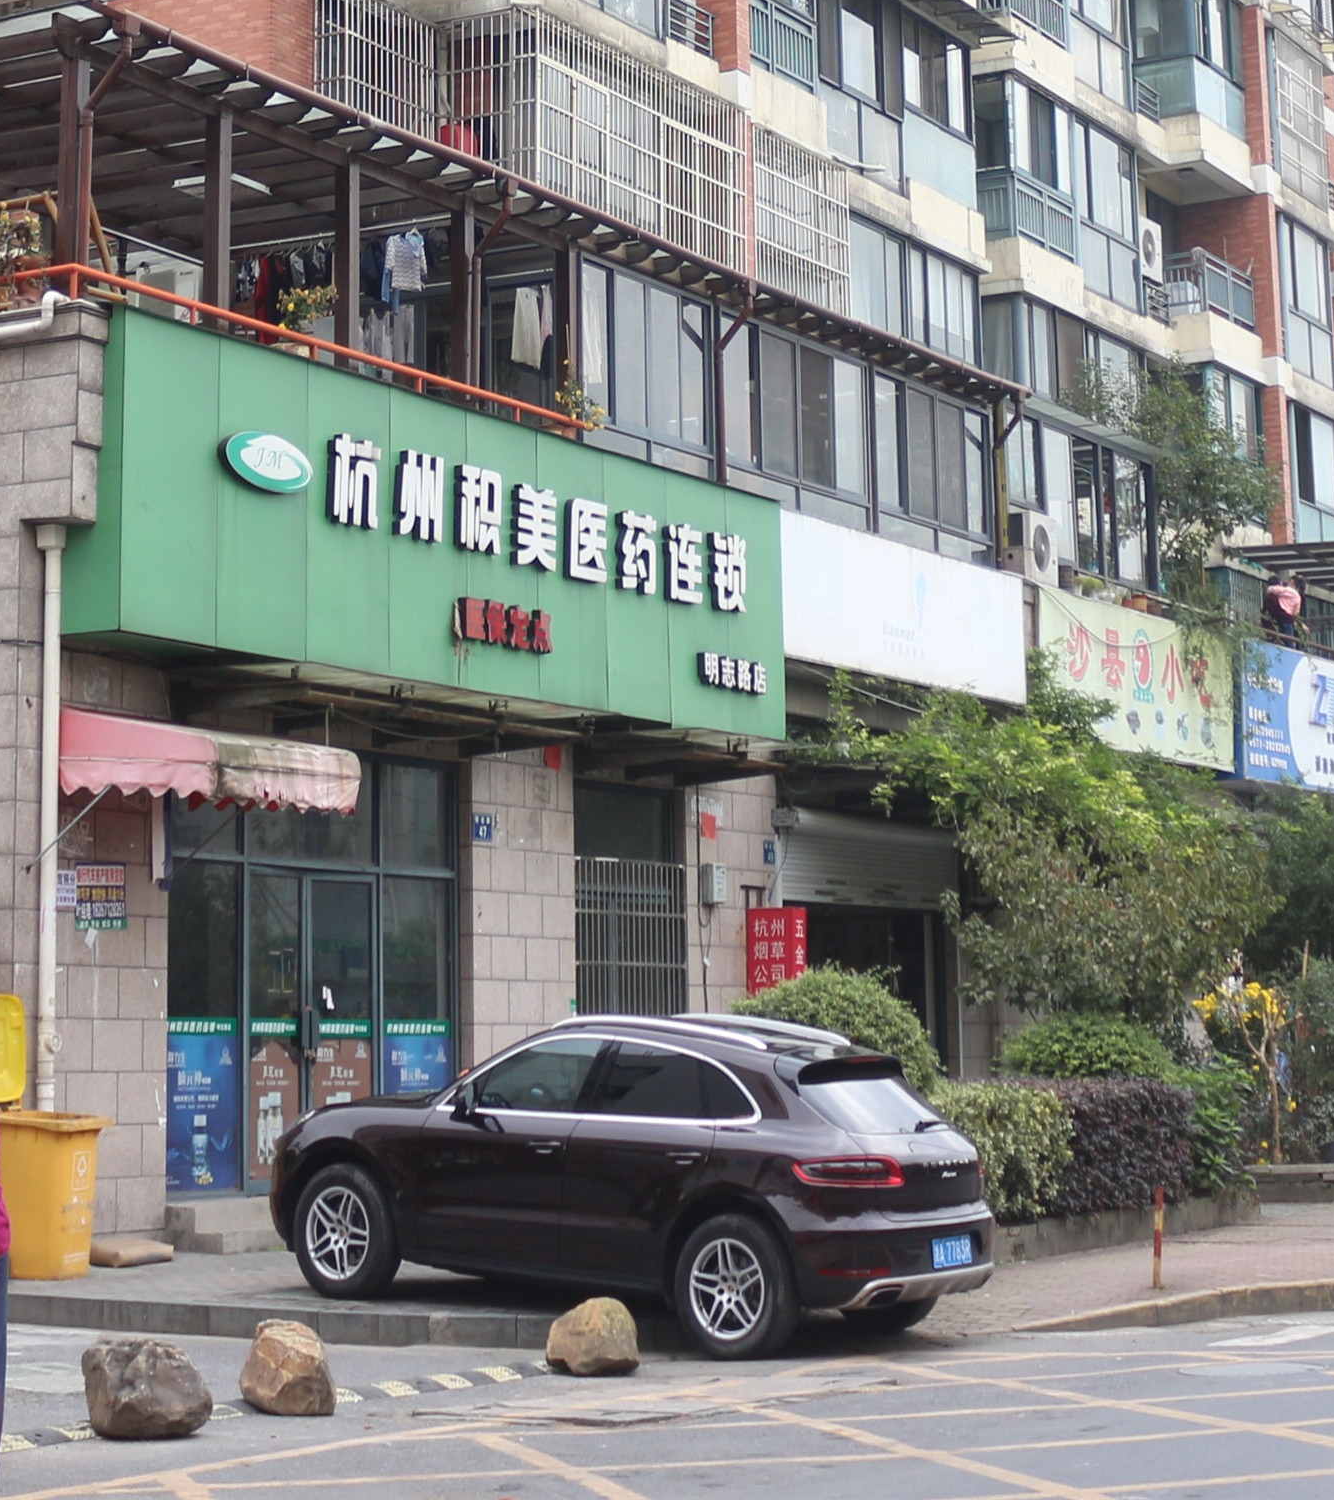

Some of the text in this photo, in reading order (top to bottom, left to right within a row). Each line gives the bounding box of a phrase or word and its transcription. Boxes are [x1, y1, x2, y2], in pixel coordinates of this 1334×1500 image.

[328, 433, 749, 613] 杭州积美医药连锁
[461, 598, 553, 653] 医保定点
[699, 653, 767, 695] 明志路店
[753, 918, 785, 938] 杭州
[753, 942, 785, 961] 烟草
[753, 965, 785, 984] 公司
